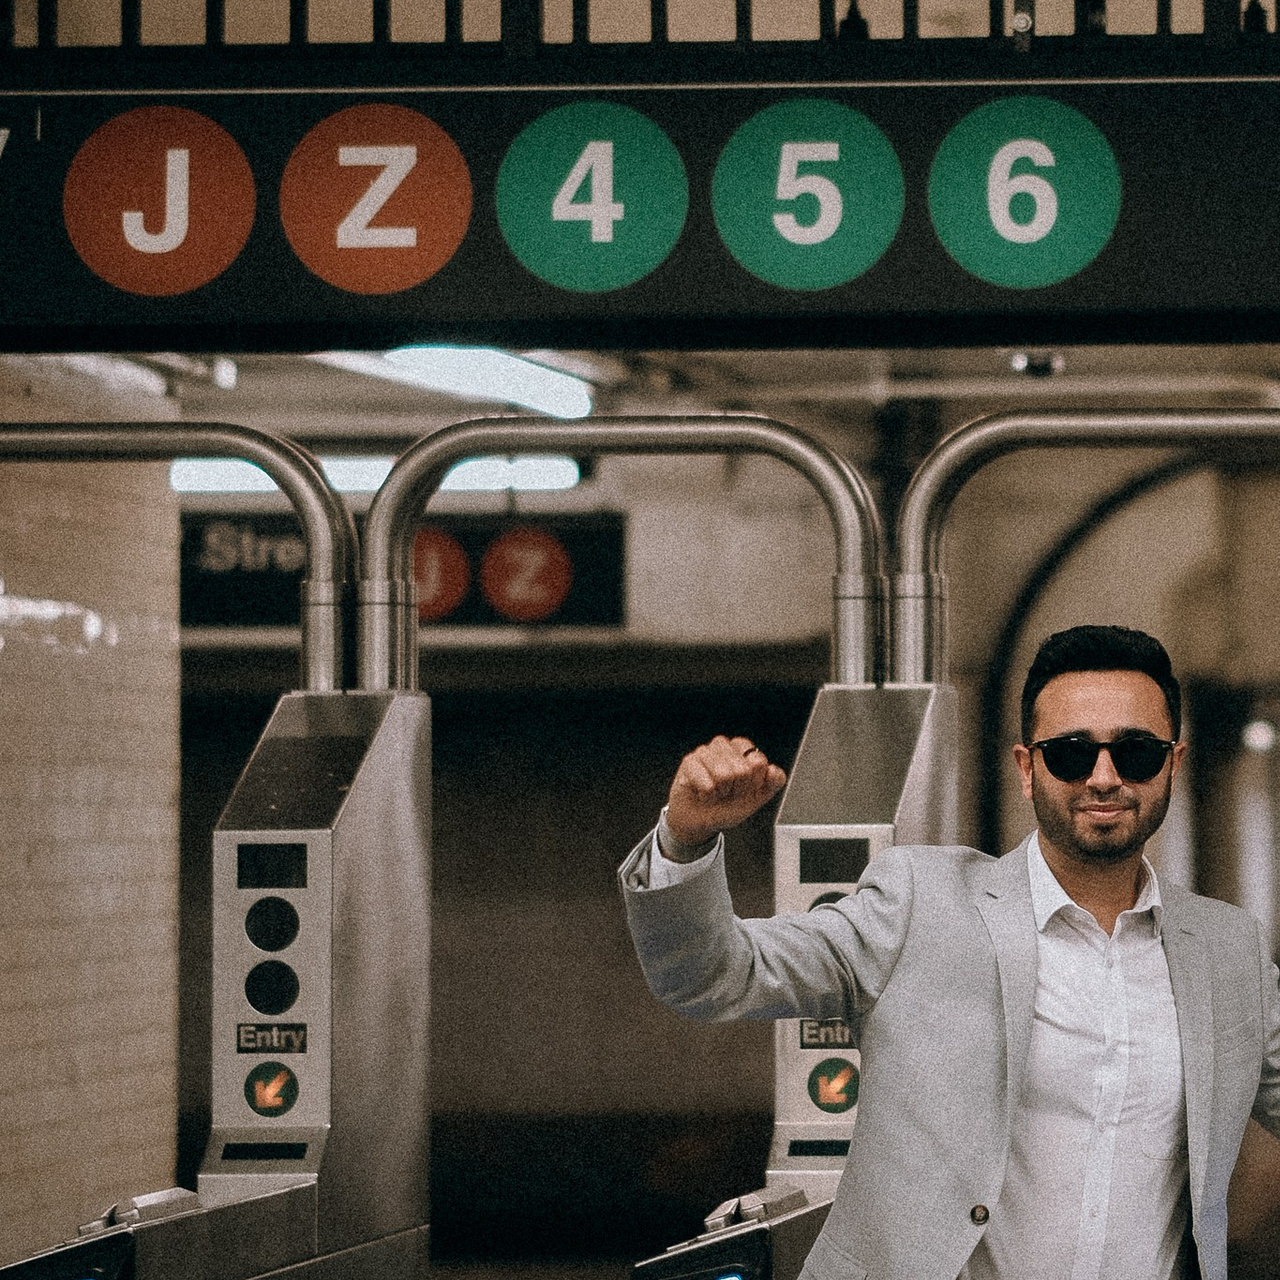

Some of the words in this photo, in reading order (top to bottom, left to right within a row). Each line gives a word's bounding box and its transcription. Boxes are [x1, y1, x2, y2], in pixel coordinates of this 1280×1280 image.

[122, 148, 190, 253] J
[336, 145, 417, 248] Z
[551, 140, 625, 244] 4
[771, 141, 844, 245] 5
[986, 138, 1059, 245] 6
[505, 547, 547, 602] Z
[239, 1026, 305, 1050] Entry
